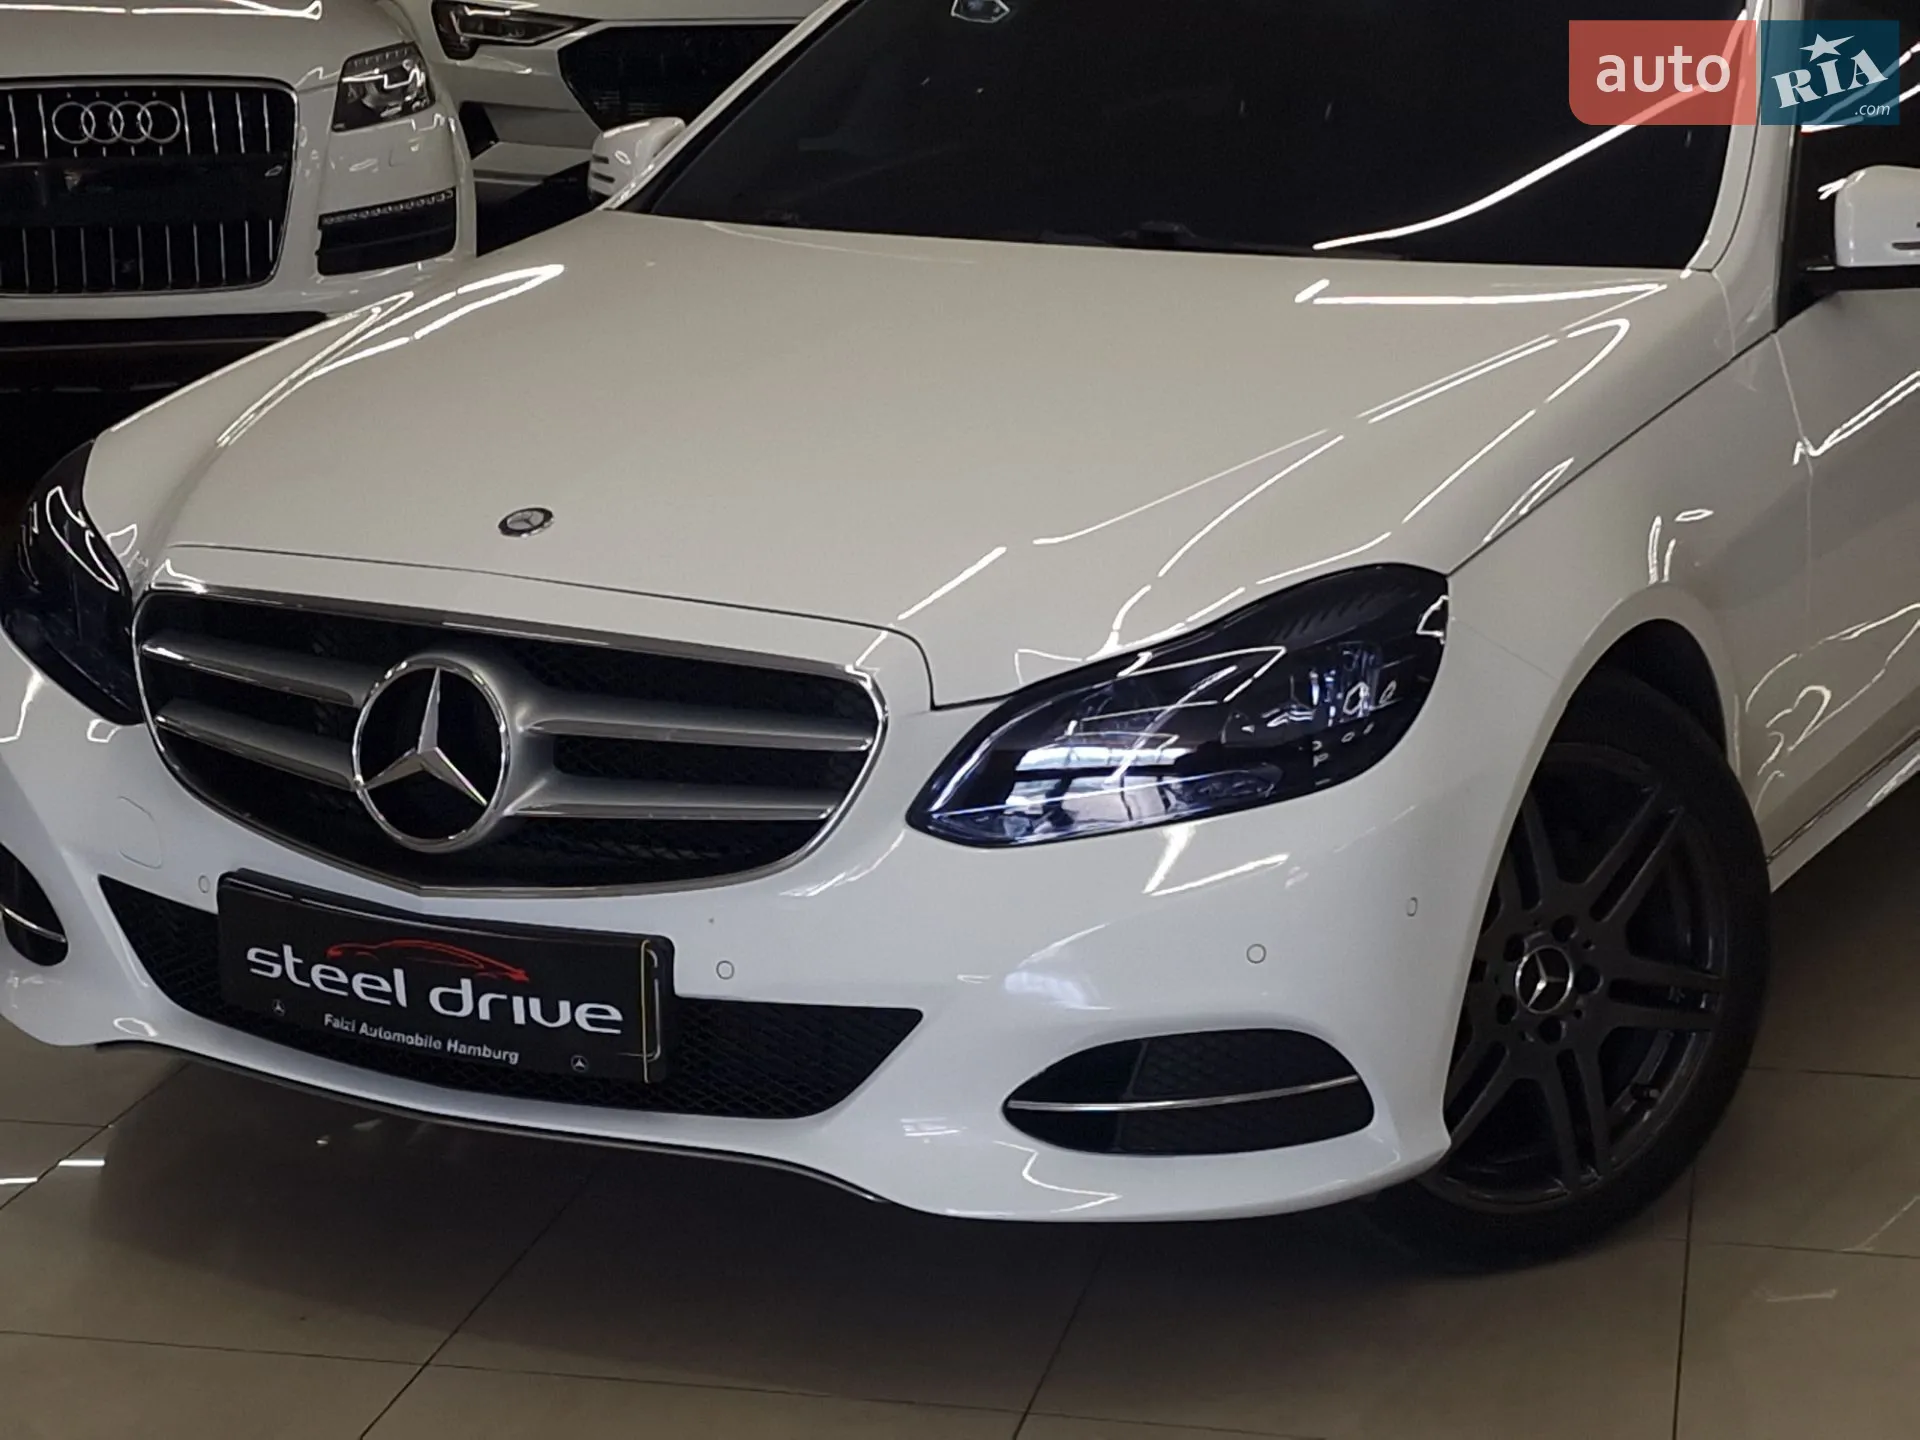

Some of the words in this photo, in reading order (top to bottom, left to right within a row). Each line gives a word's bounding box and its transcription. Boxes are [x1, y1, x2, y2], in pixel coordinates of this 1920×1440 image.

[246, 943, 406, 1008] steel
[428, 977, 624, 1035] drive
[359, 1021, 442, 1050] Automobile
[446, 1038, 520, 1065] Hamburg
